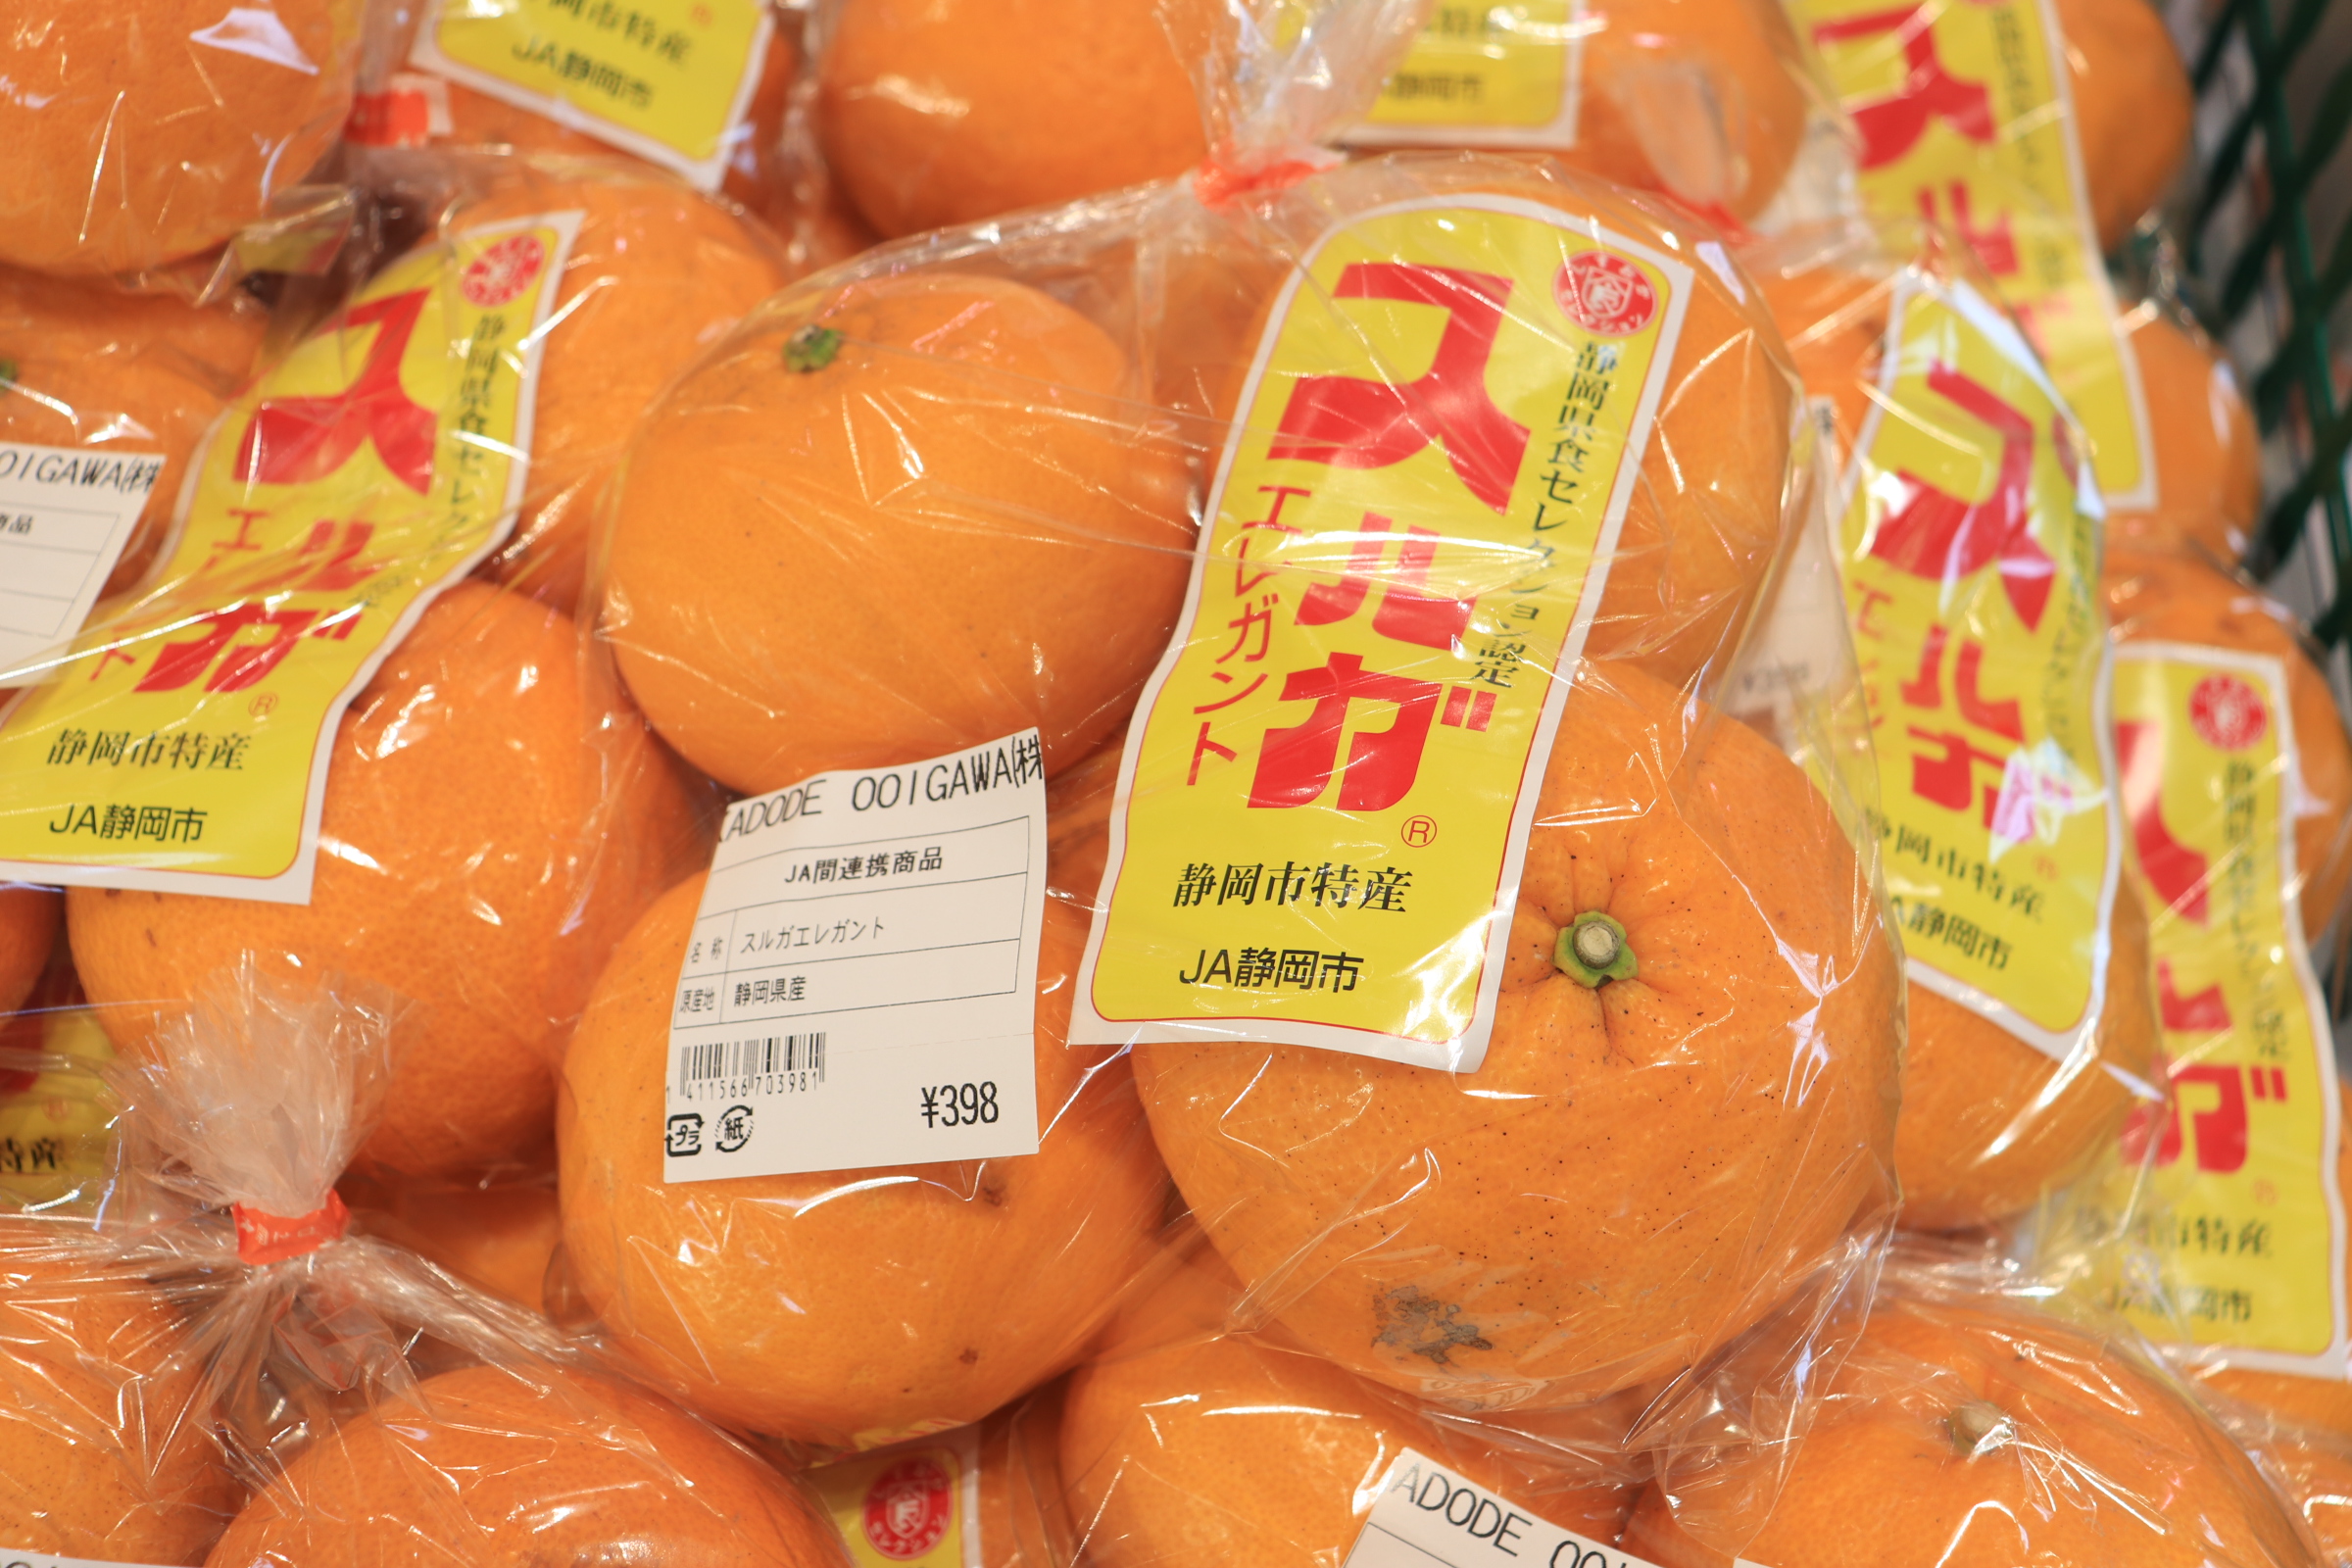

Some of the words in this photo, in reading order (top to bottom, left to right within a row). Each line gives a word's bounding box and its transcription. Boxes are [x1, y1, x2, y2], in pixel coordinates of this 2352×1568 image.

[1247, 262, 1531, 811] スルガ
[1187, 485, 1312, 787] エレガント
[46, 728, 252, 771] 静岡市特産
[49, 804, 209, 844] JA静岡市
[718, 778, 827, 843] ADODE
[784, 846, 943, 885] JA間連携商品
[1172, 860, 1413, 913] 静岡市特産
[739, 915, 885, 956] スルガエレガント
[678, 987, 716, 1014] 原産地
[733, 974, 807, 1007] 静岡県産
[1178, 946, 1365, 994] JA静岡市
[920, 1080, 1000, 1129] ¥398
